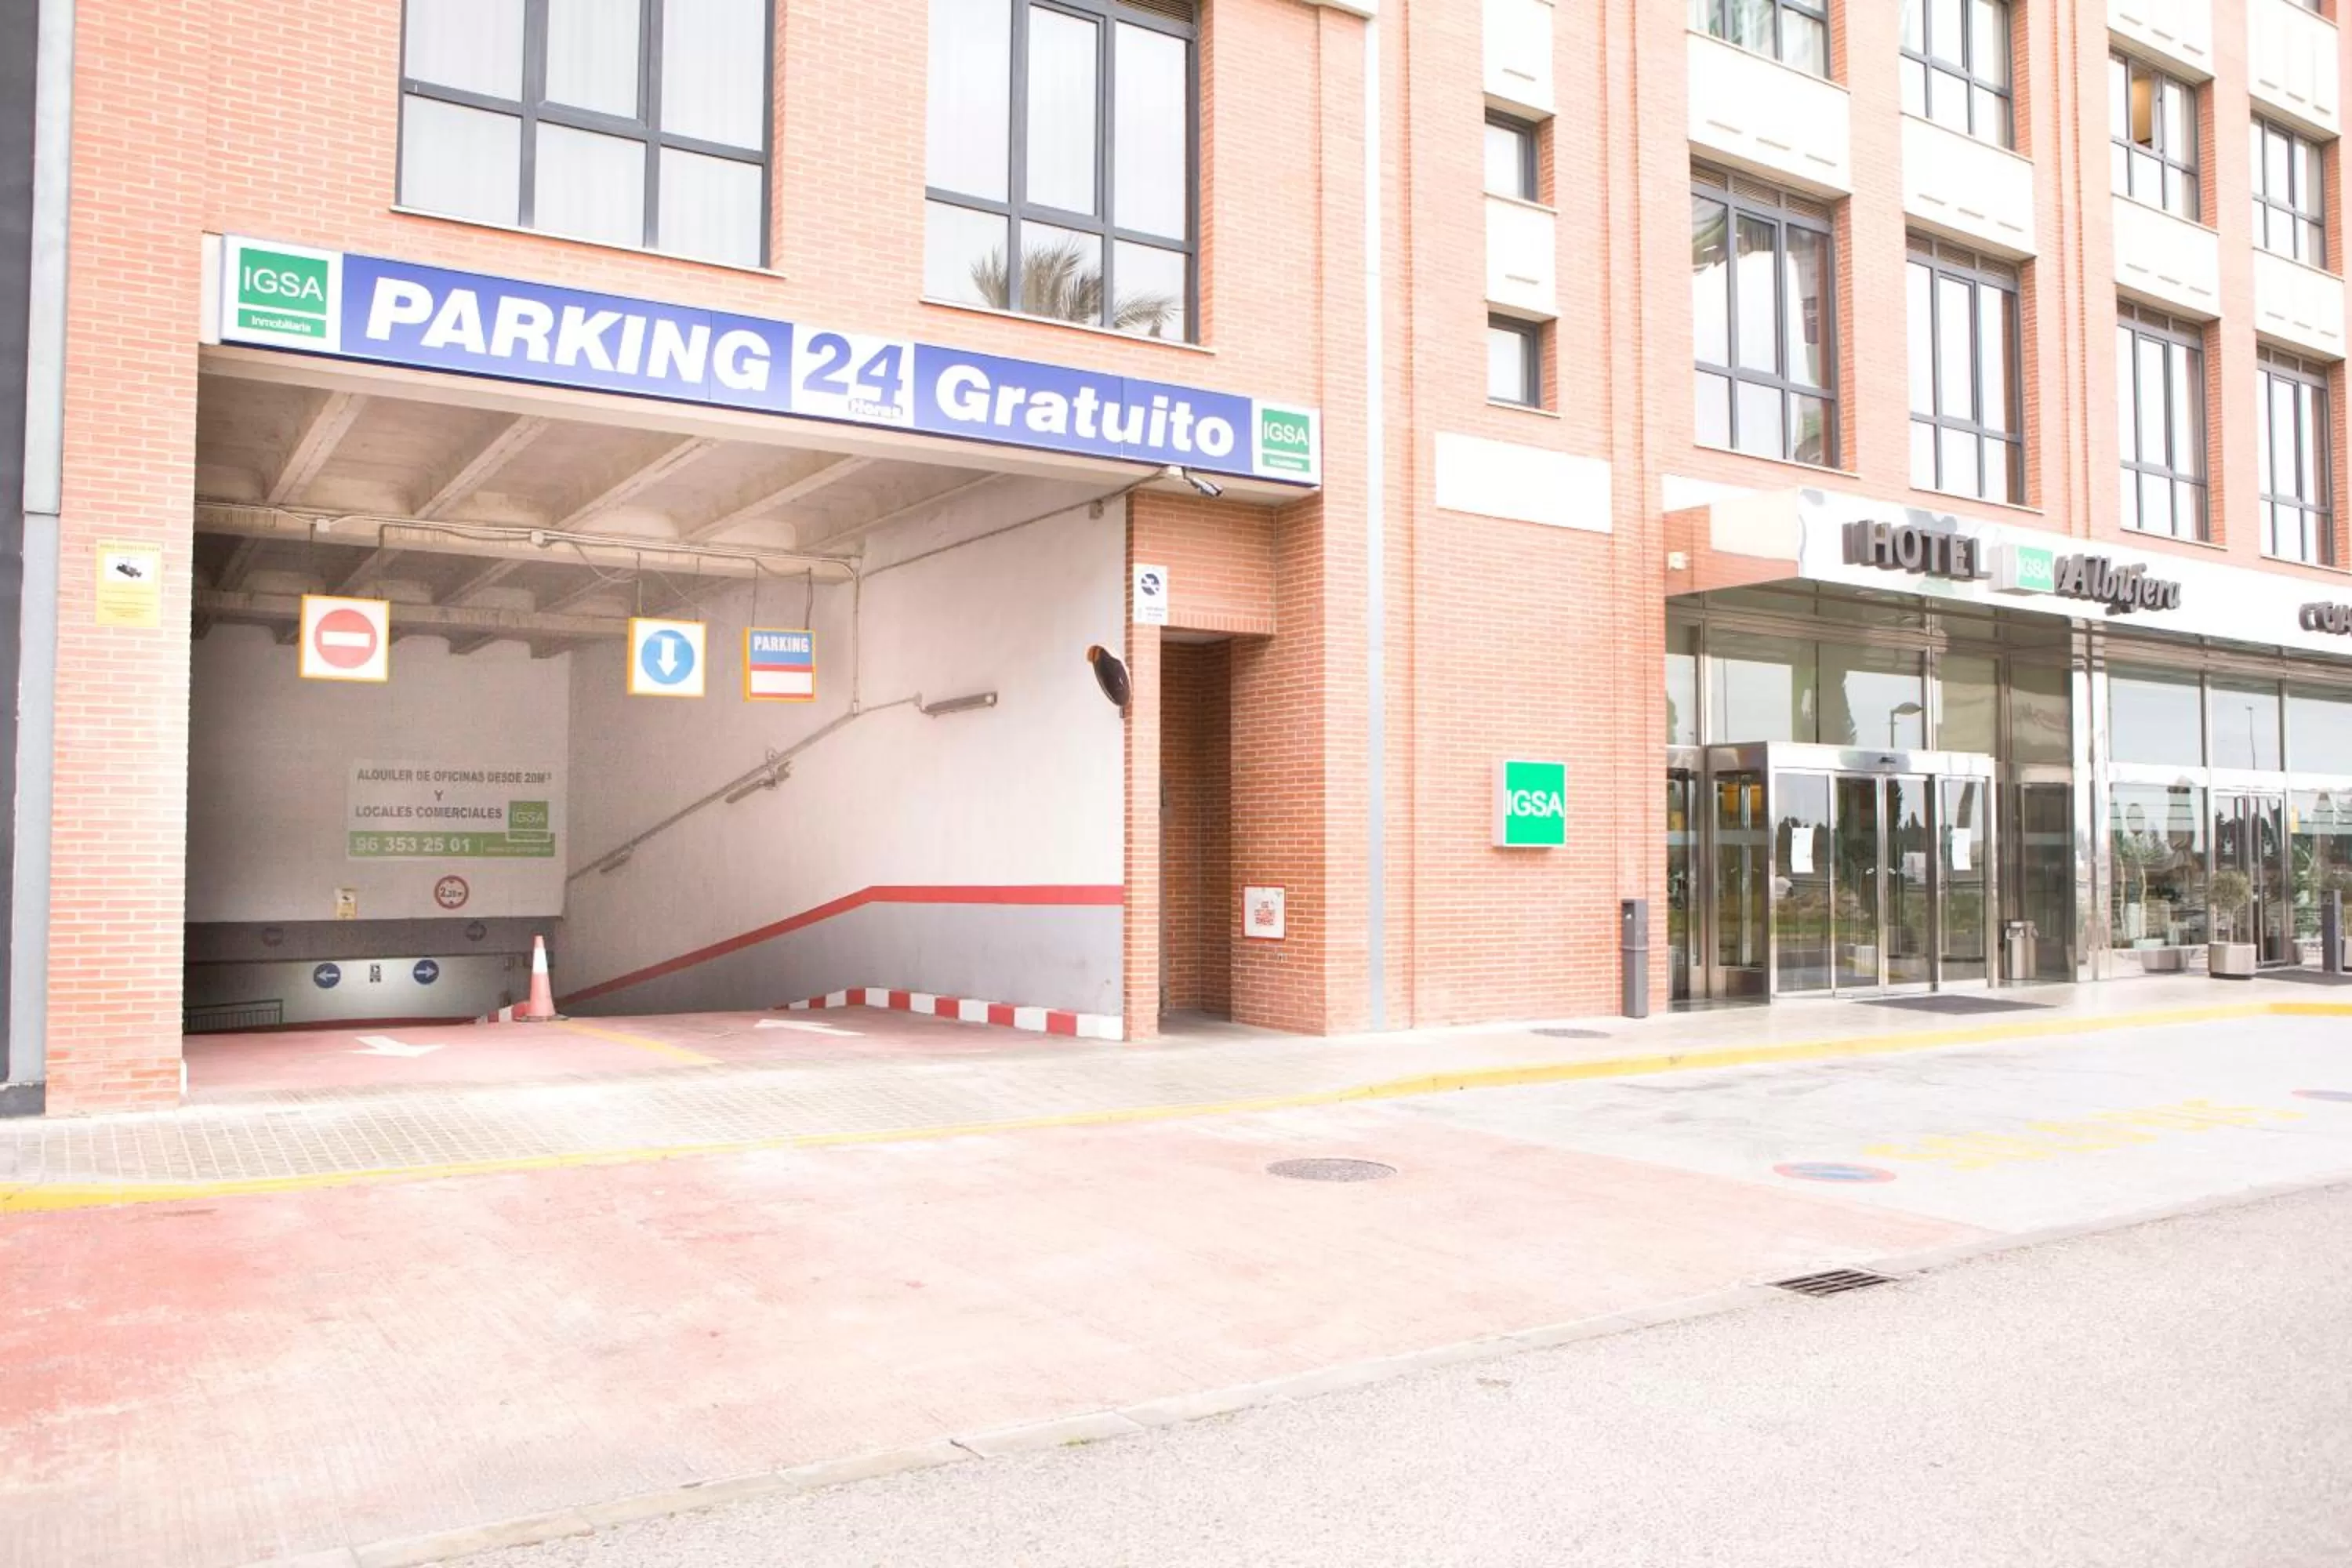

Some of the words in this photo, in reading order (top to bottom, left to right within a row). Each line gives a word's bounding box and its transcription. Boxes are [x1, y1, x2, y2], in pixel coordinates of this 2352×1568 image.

[244, 264, 325, 302] IGSA
[251, 314, 311, 333] Inmobiliaria
[365, 277, 771, 392] PARKING
[802, 332, 904, 406] 24
[935, 363, 1236, 456] Gratuito
[1263, 419, 1308, 446] IGSA
[1844, 519, 1993, 580] HOTEL
[753, 636, 809, 653] PARKING
[357, 768, 412, 782] ALQUILER
[416, 771, 430, 782] DE
[434, 771, 485, 782] OFICINAS
[488, 771, 521, 783] DESDE
[434, 789, 444, 801] Y
[355, 806, 412, 818] LOCALES
[416, 806, 503, 819] COMERCIALES
[355, 837, 379, 852] 96
[385, 837, 418, 852] 353
[423, 837, 445, 852] 25
[449, 837, 470, 852] 01
